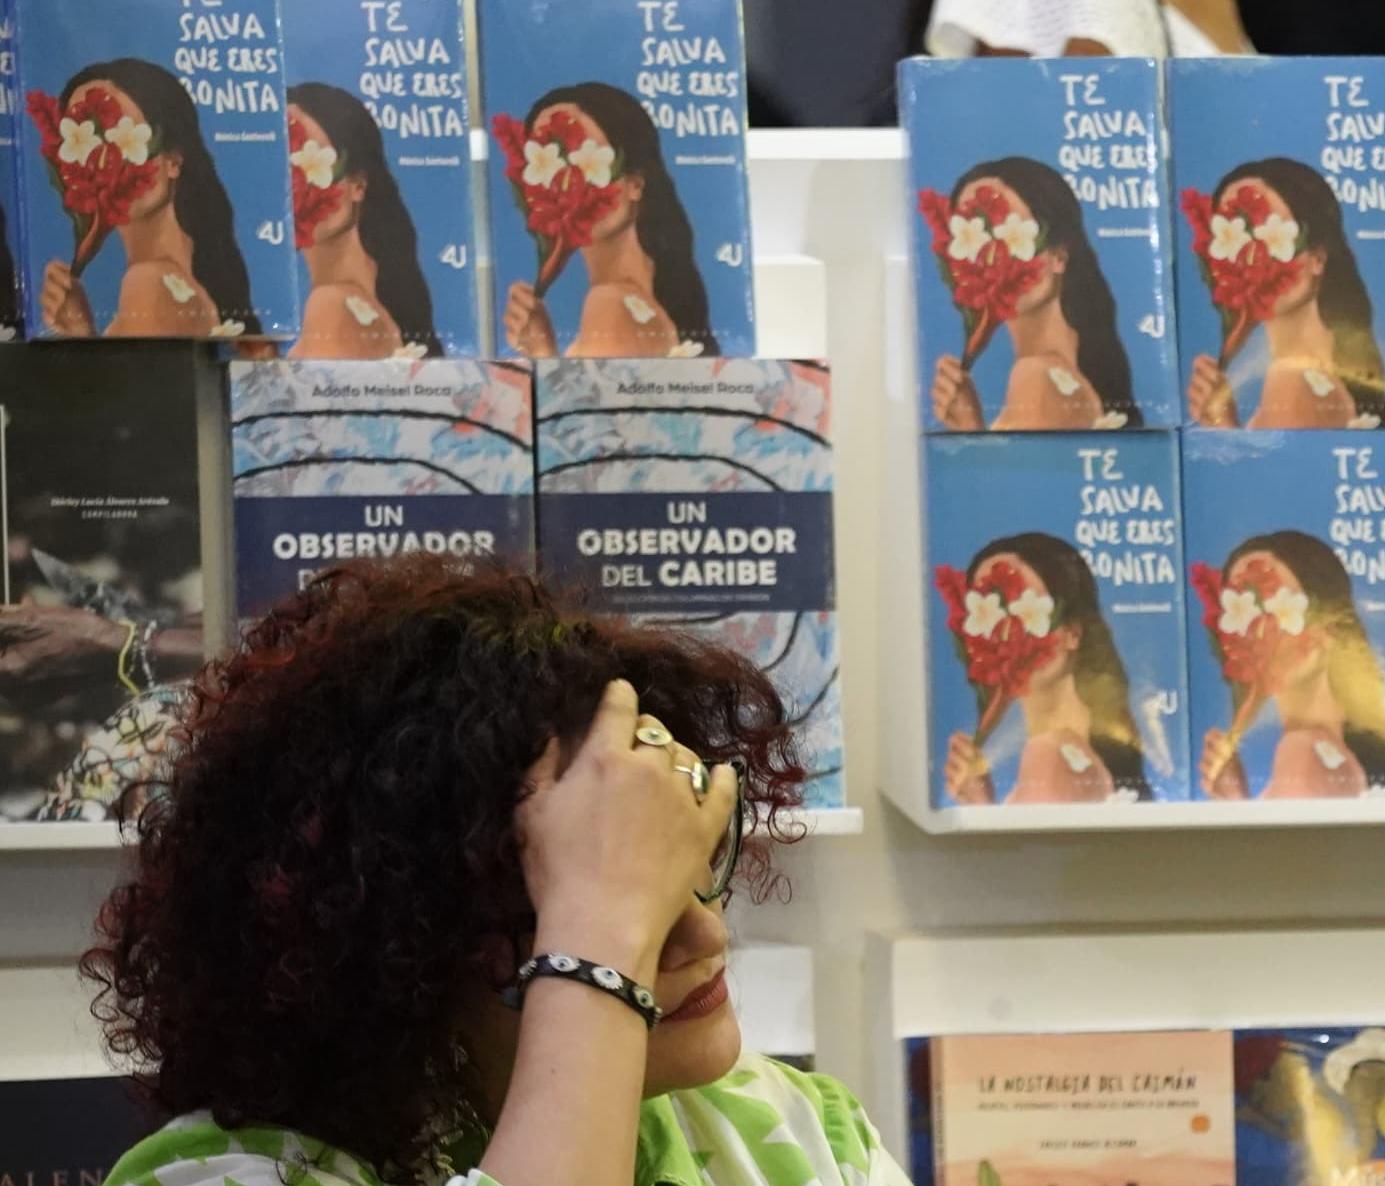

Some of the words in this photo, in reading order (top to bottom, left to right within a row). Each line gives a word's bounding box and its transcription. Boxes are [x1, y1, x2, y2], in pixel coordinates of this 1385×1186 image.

[179, 12, 265, 43] SALVA
[360, 1, 409, 32] TE
[637, 0, 685, 32] TE
[174, 46, 222, 75] QUE
[227, 47, 278, 74] ERES
[365, 37, 450, 68] SALVA
[642, 36, 726, 67] SALVA
[359, 71, 406, 100] QUE
[411, 73, 463, 98] ERES
[636, 71, 683, 100] QUE
[688, 71, 739, 98] ERES
[1059, 74, 1106, 106] TE
[1324, 75, 1369, 108] TE
[1063, 111, 1146, 139] SALVA
[1058, 144, 1105, 173] QUE
[1110, 144, 1158, 171] ERES
[1321, 146, 1366, 174] QUE
[312, 384, 360, 398] Adolfo
[363, 384, 411, 397] Meisel
[415, 383, 452, 397] Roca
[617, 382, 664, 395] Adolfo
[668, 382, 714, 395] Meisel
[718, 382, 754, 395] Roca
[1077, 448, 1123, 481] TE
[1332, 447, 1378, 480] TE
[667, 502, 707, 524] UN
[1081, 485, 1163, 516] SALVA
[365, 506, 404, 527] UN
[273, 531, 496, 559] OBSERVADOR
[577, 529, 797, 556] OBSERVADOR
[1075, 519, 1121, 548] QUE
[1126, 519, 1175, 545] ERES
[1330, 518, 1376, 547] QUE
[602, 566, 653, 588] DEL
[658, 560, 778, 586] CARIBE
[979, 1074, 997, 1093] LA
[1004, 1073, 1091, 1095] NOSTALGIA
[1098, 1074, 1124, 1093] DEL
[1132, 1067, 1198, 1094] CAIMÁN
